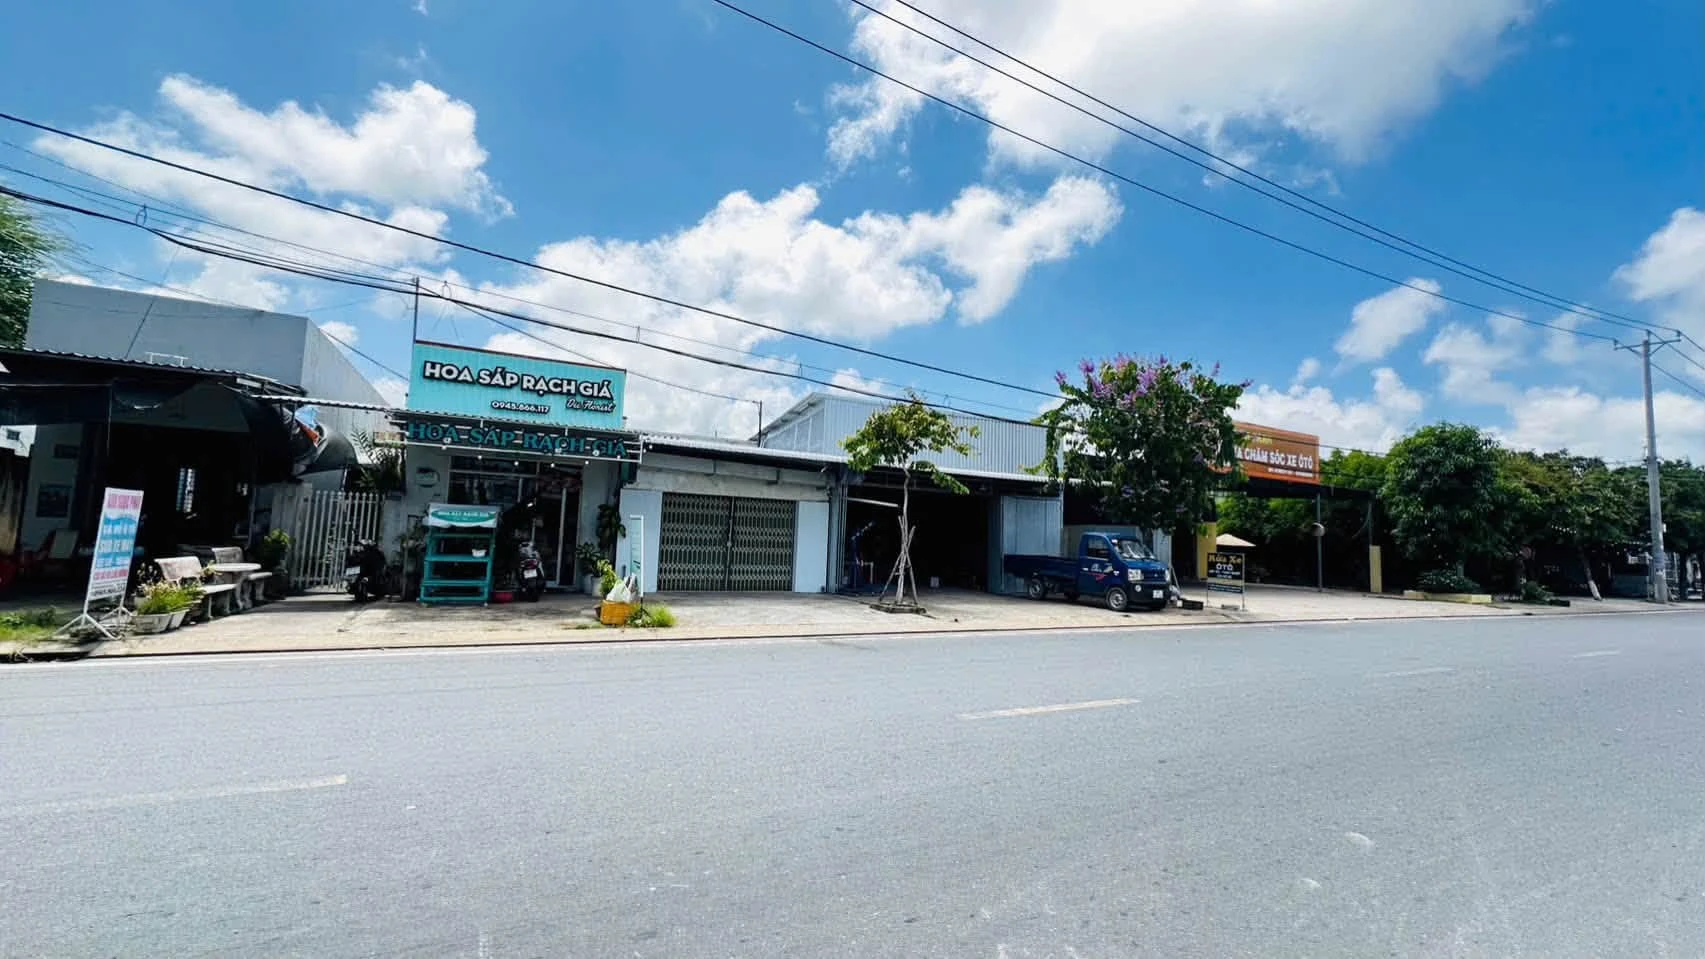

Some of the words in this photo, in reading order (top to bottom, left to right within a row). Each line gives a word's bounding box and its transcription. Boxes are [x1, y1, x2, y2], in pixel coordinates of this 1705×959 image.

[424, 361, 473, 382] HOA
[478, 367, 519, 386] SÁP
[522, 375, 576, 396] RẠCH
[579, 380, 612, 398] GIÁ
[408, 423, 460, 443] HOA
[469, 426, 516, 446] SÁP
[523, 432, 585, 453] RẠCH
[592, 438, 626, 457] GIÁ
[1269, 449, 1286, 466] SÓC
[1286, 454, 1297, 467] XE
